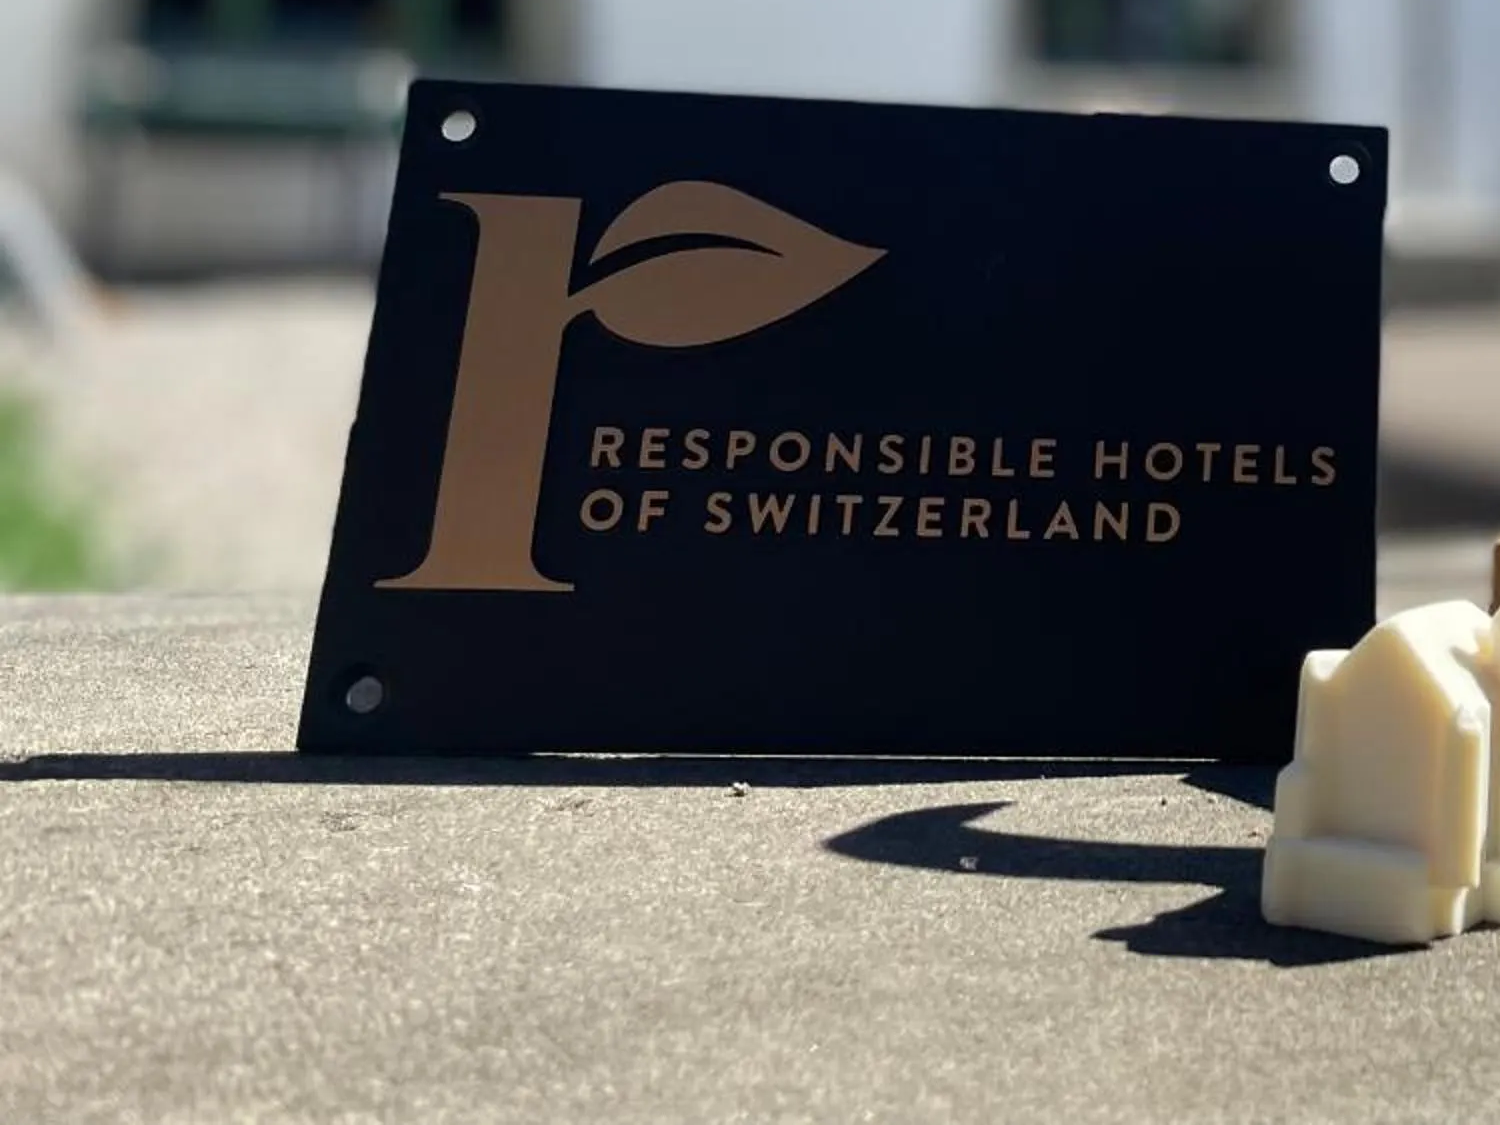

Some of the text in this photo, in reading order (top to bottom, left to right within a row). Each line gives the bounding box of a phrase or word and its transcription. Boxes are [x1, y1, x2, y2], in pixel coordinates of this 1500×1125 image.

[591, 426, 1336, 486] RESPONSIBLE HOTELS
[579, 489, 1181, 542] OF SWITZERLAND
